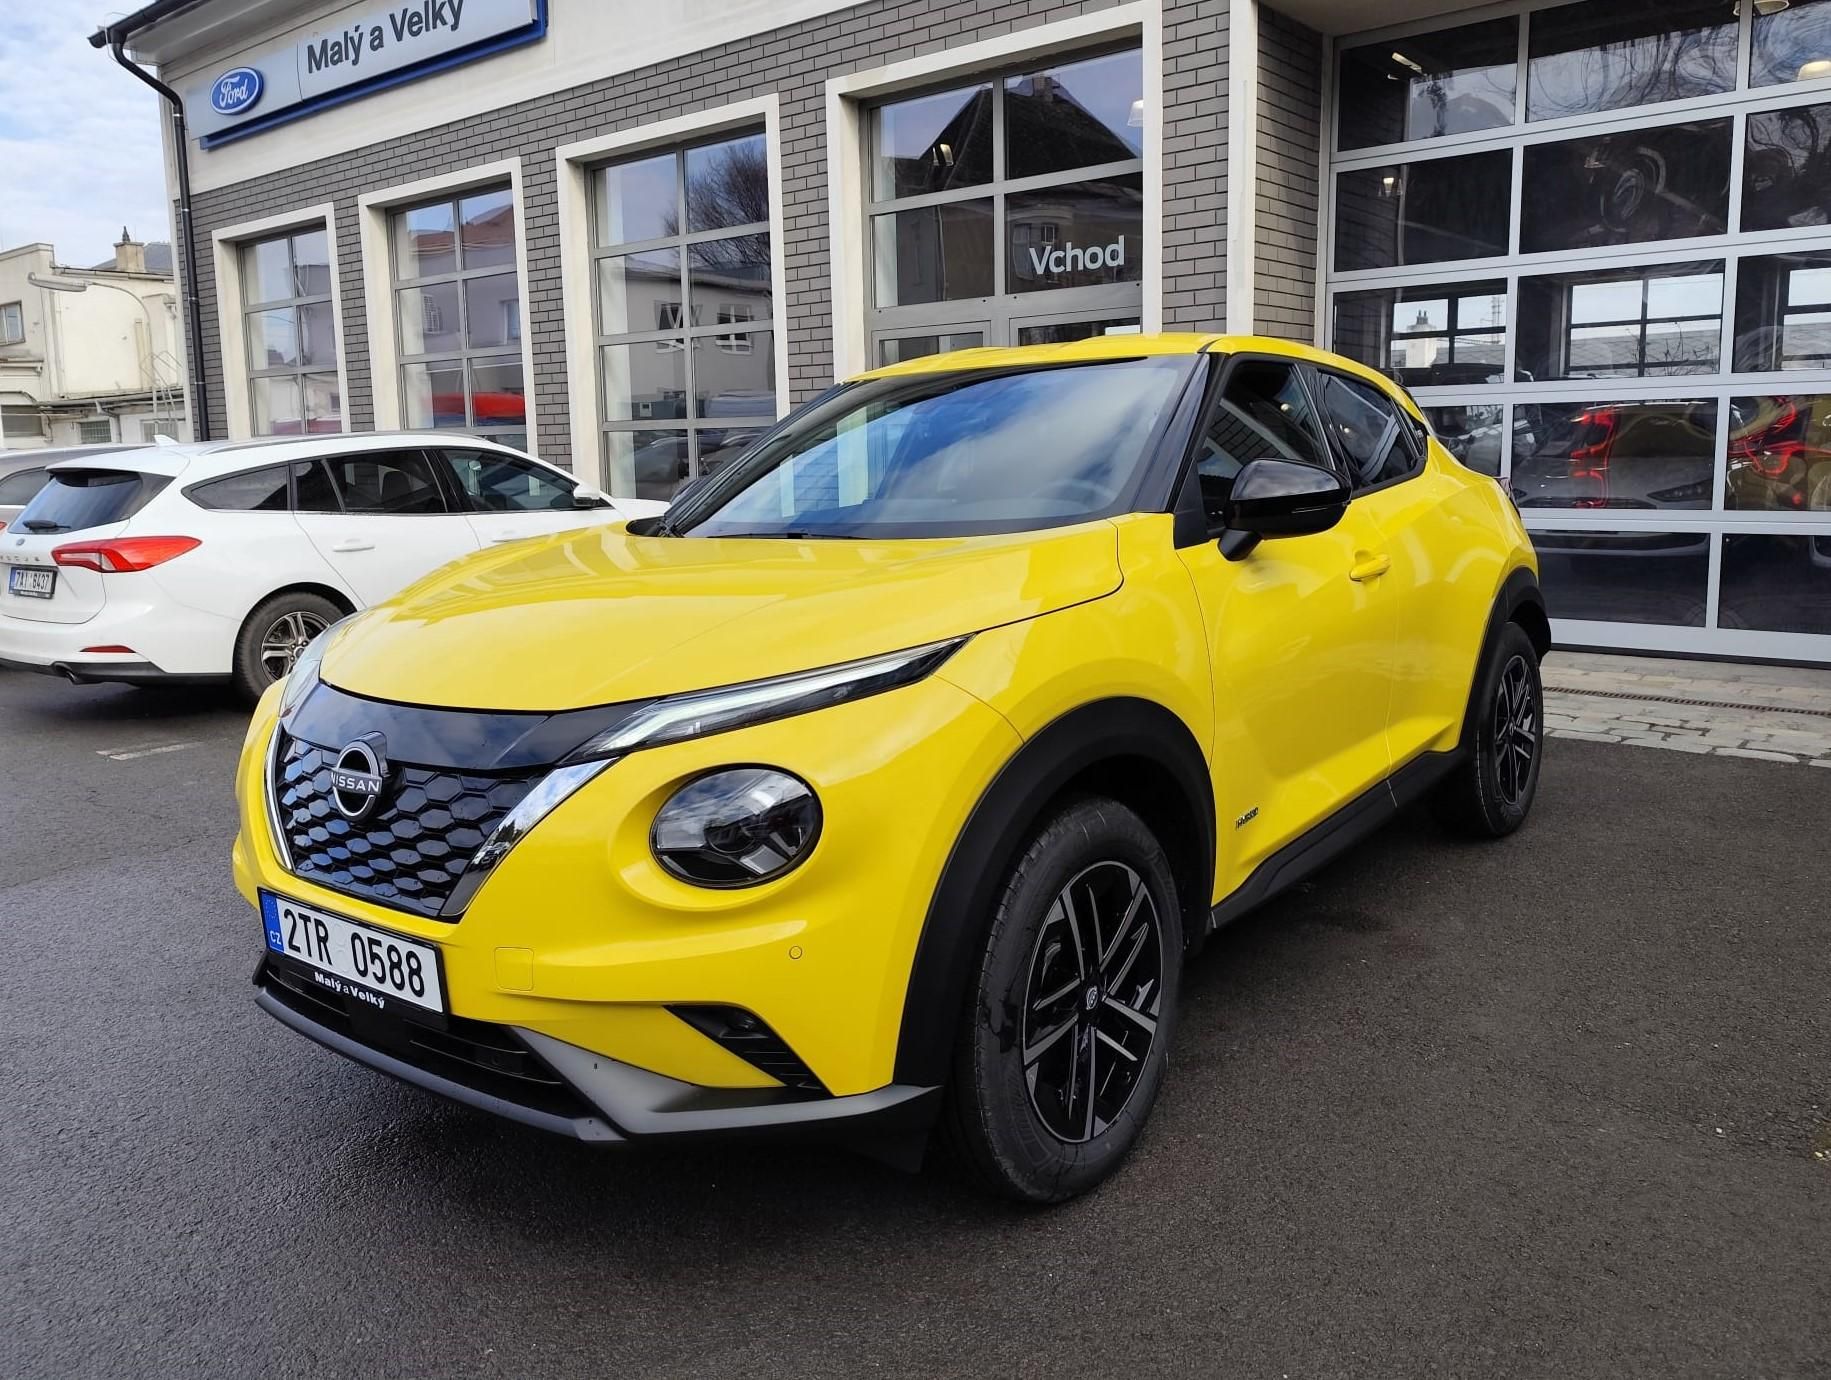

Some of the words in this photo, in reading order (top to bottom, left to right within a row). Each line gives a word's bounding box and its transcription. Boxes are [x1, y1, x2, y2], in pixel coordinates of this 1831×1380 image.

[307, 25, 363, 74] Malý
[369, 25, 384, 51] a
[219, 75, 248, 108] Ford
[1029, 234, 1125, 275] Vchod
[331, 770, 380, 793] NISSAN
[269, 930, 282, 945] CZ
[284, 908, 333, 966] 2TR
[350, 932, 425, 998] 0588
[314, 971, 341, 992] Malý
[343, 985, 350, 994] a
[350, 986, 385, 1009] Velký
